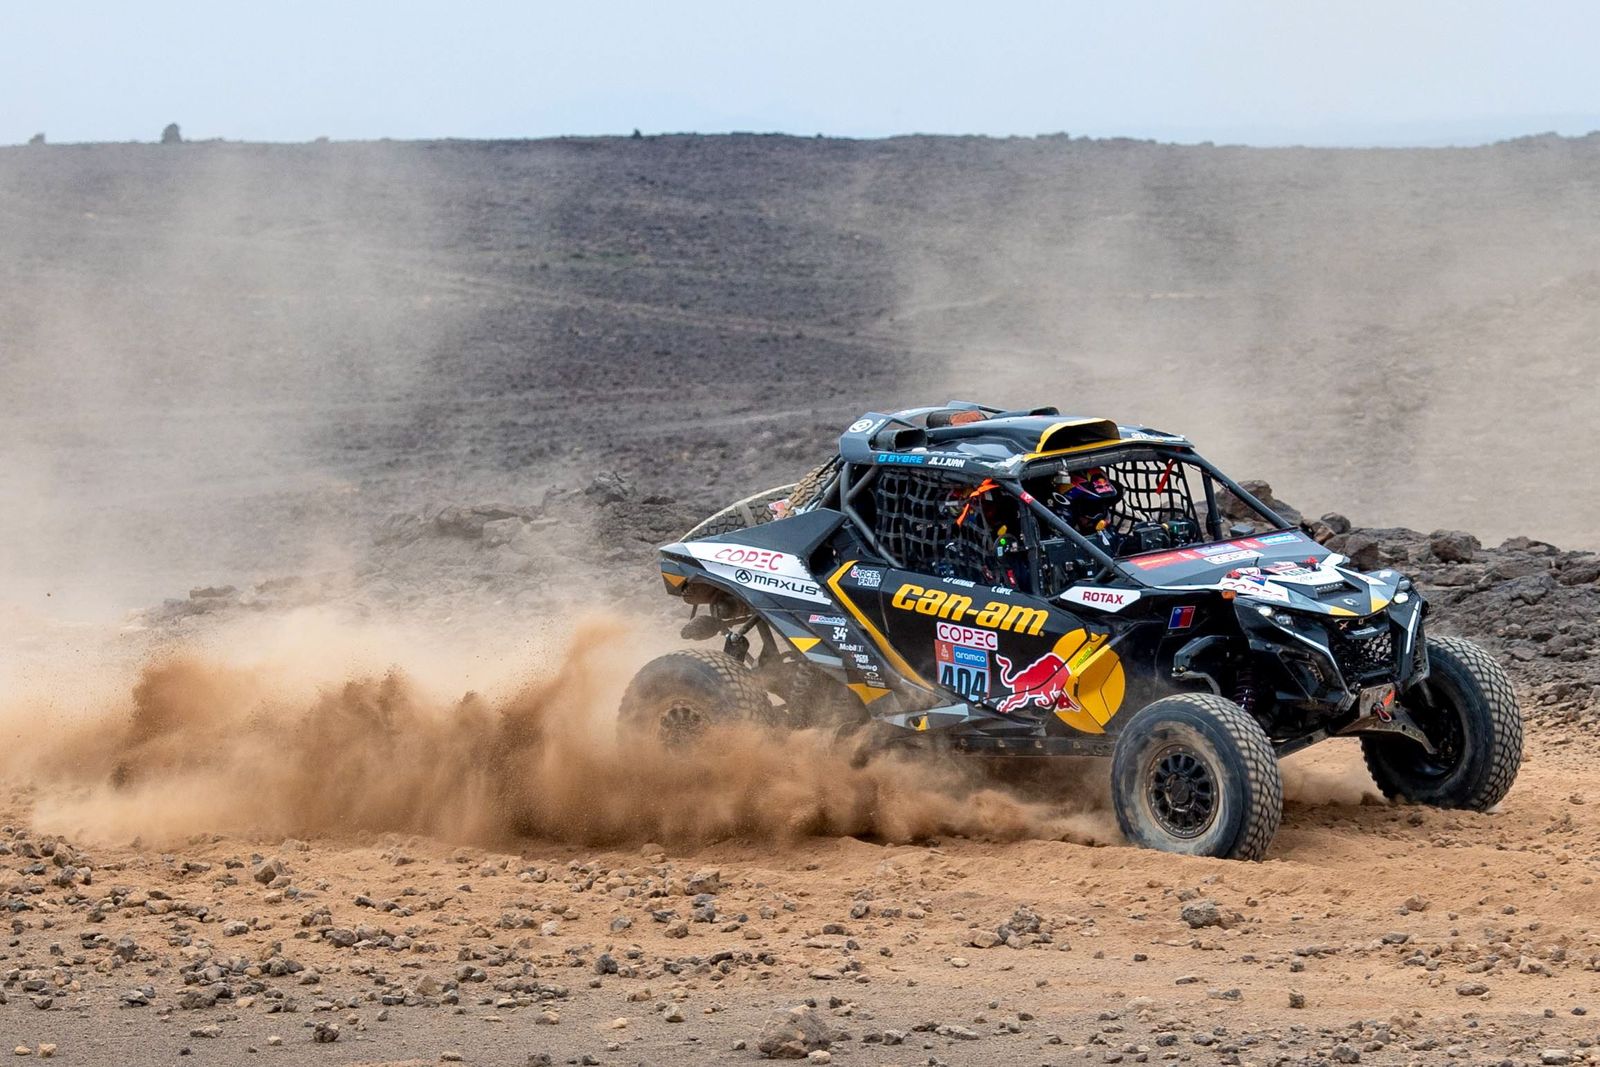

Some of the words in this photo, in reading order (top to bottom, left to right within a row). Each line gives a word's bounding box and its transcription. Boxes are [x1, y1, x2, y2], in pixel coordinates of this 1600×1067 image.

[715, 548, 783, 571] COPEC
[754, 574, 819, 596] MAXUS
[891, 583, 1049, 636] can-am
[1082, 591, 1124, 605] ROTAX
[938, 624, 997, 648] COPEC
[955, 651, 986, 663] aramco
[941, 664, 988, 703] 404
